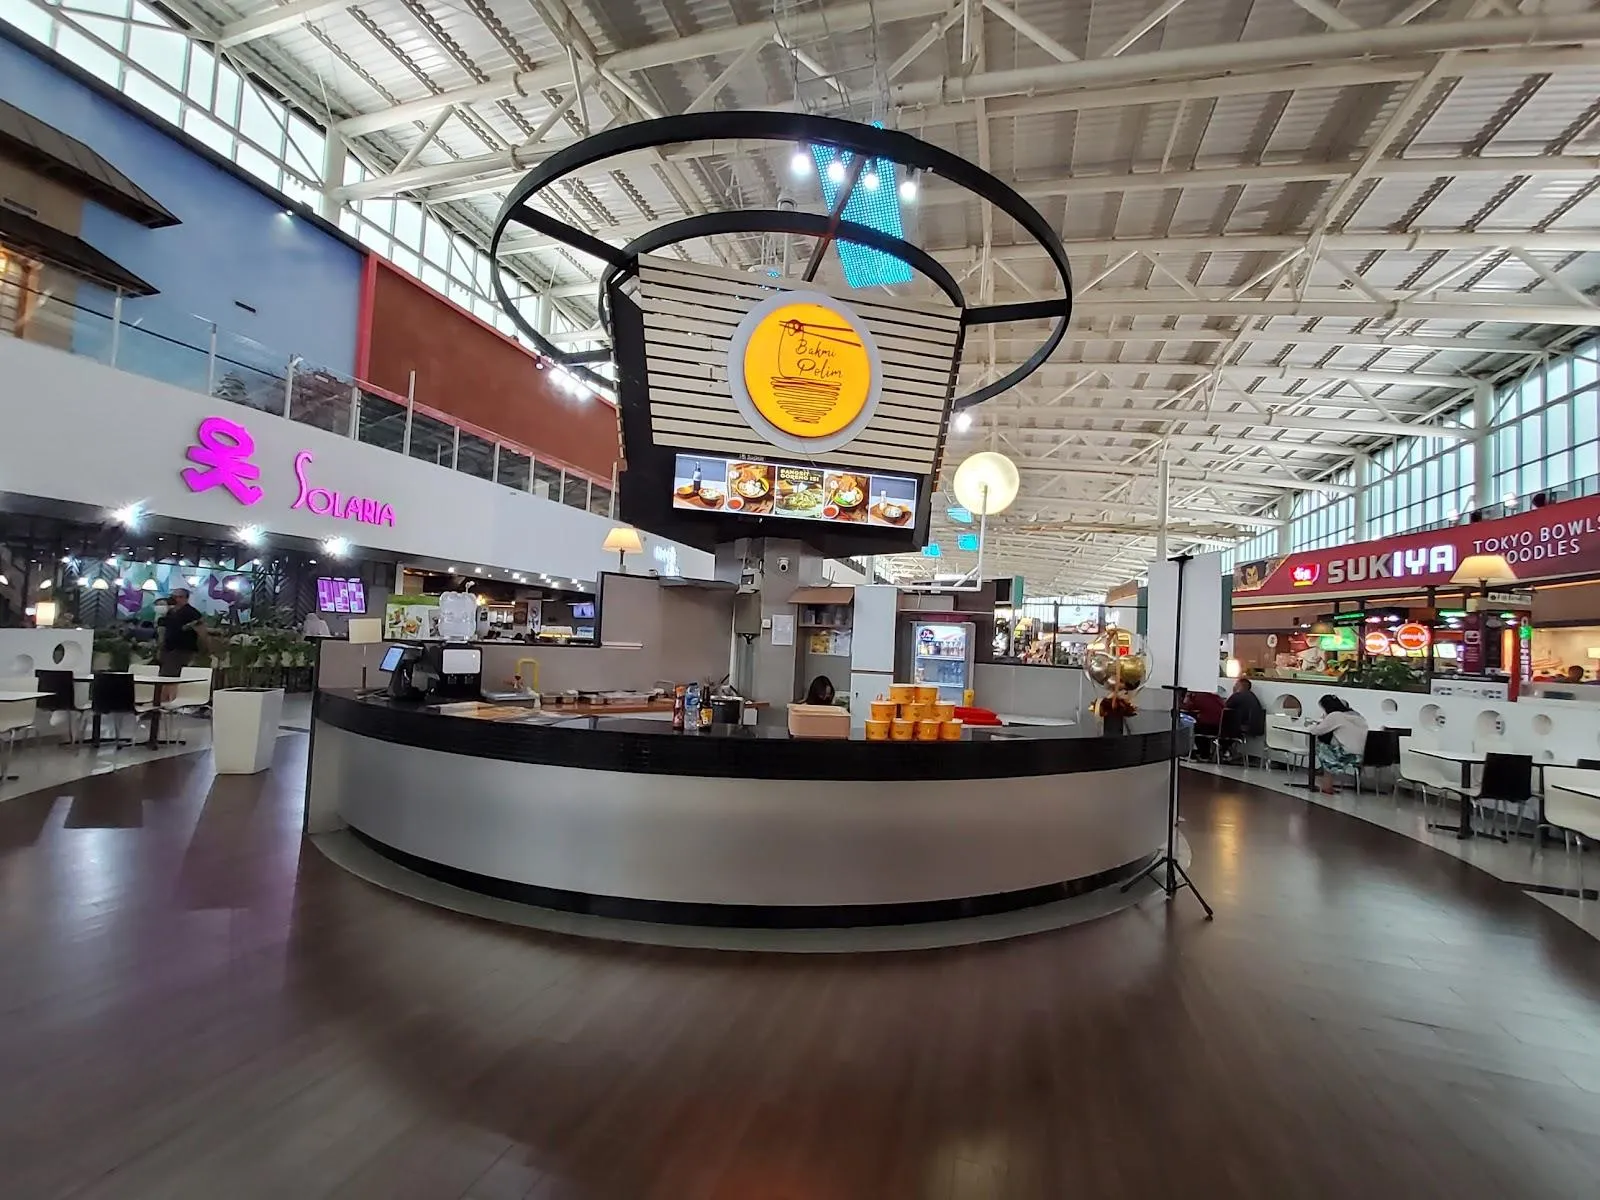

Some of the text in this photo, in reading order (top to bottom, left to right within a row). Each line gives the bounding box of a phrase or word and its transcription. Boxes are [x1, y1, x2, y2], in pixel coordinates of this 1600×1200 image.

[796, 339, 836, 358] Bakmi
[291, 451, 396, 527] SOLARIA
[1473, 515, 1600, 554] TOKYO BOWL
[1501, 538, 1580, 564] OODLES
[1327, 544, 1457, 584] SUKIYA
